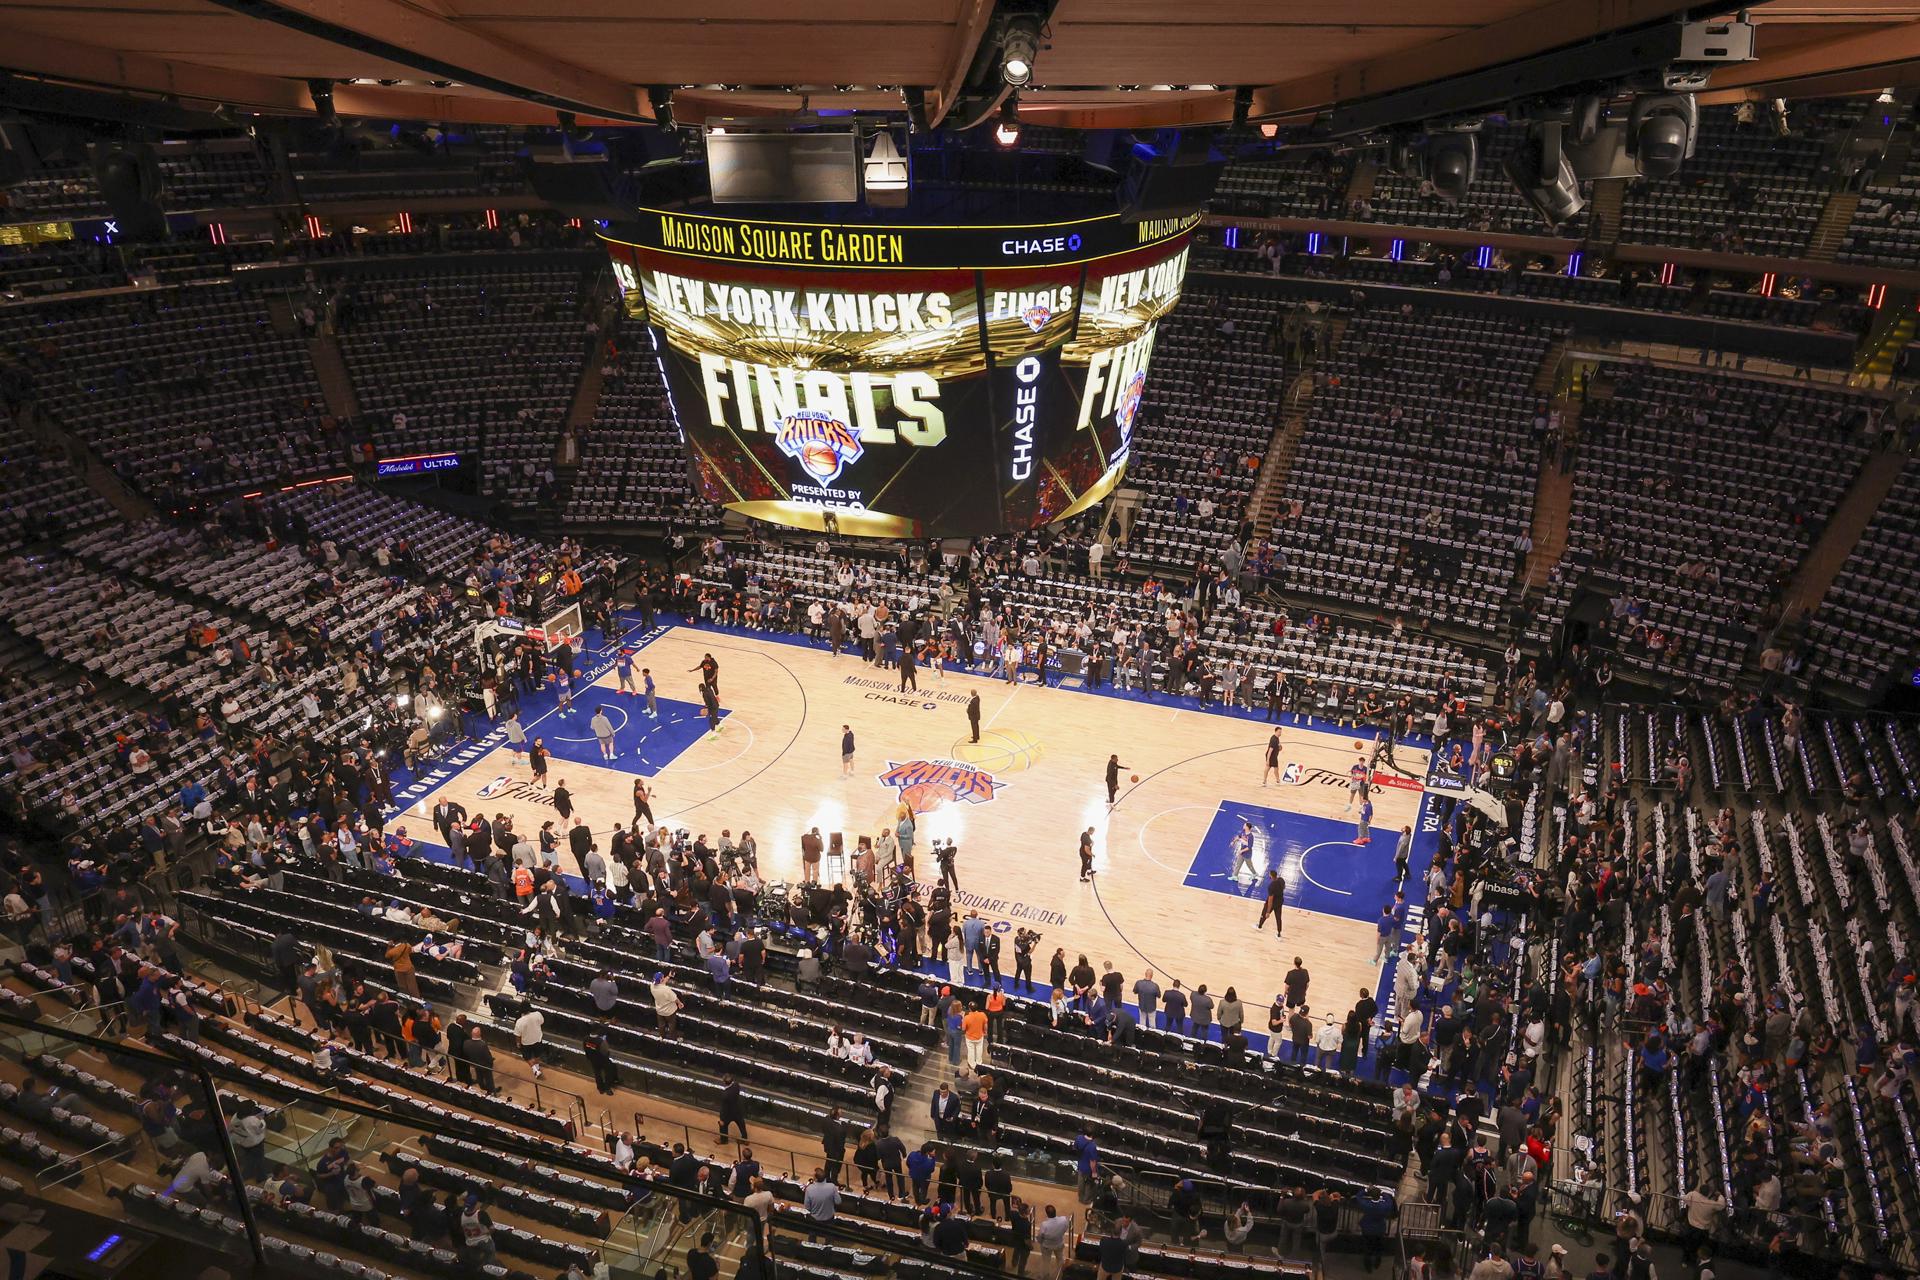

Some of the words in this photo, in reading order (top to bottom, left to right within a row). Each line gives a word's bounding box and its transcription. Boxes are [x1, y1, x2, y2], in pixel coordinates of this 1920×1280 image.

[661, 215, 735, 255] MADISON
[740, 224, 815, 260] SQUARE
[820, 229, 904, 263] GARDEN
[1002, 237, 1065, 255] CHASE
[652, 270, 706, 318] NEW
[709, 282, 802, 330] YORK
[806, 291, 953, 333] KNICKS
[993, 285, 1073, 319] FINALS
[1100, 269, 1146, 313] NEW
[699, 352, 948, 447] FINALS
[779, 417, 859, 453] KNICKS
[1012, 386, 1038, 480] CHASE
[423, 459, 459, 469] ULTRA
[792, 483, 846, 499] PRESENTED
[848, 490, 861, 500] BY
[628, 625, 670, 649] ULTRA
[843, 675, 893, 691] MADISON
[864, 692, 920, 708] CHASE
[395, 768, 452, 801] YORK
[879, 760, 994, 801] KNICKS
[1396, 780, 1409, 788] State
[1485, 881, 1520, 896] inbase
[953, 890, 1010, 913] SQUARE
[1010, 902, 1068, 926] GARDEN
